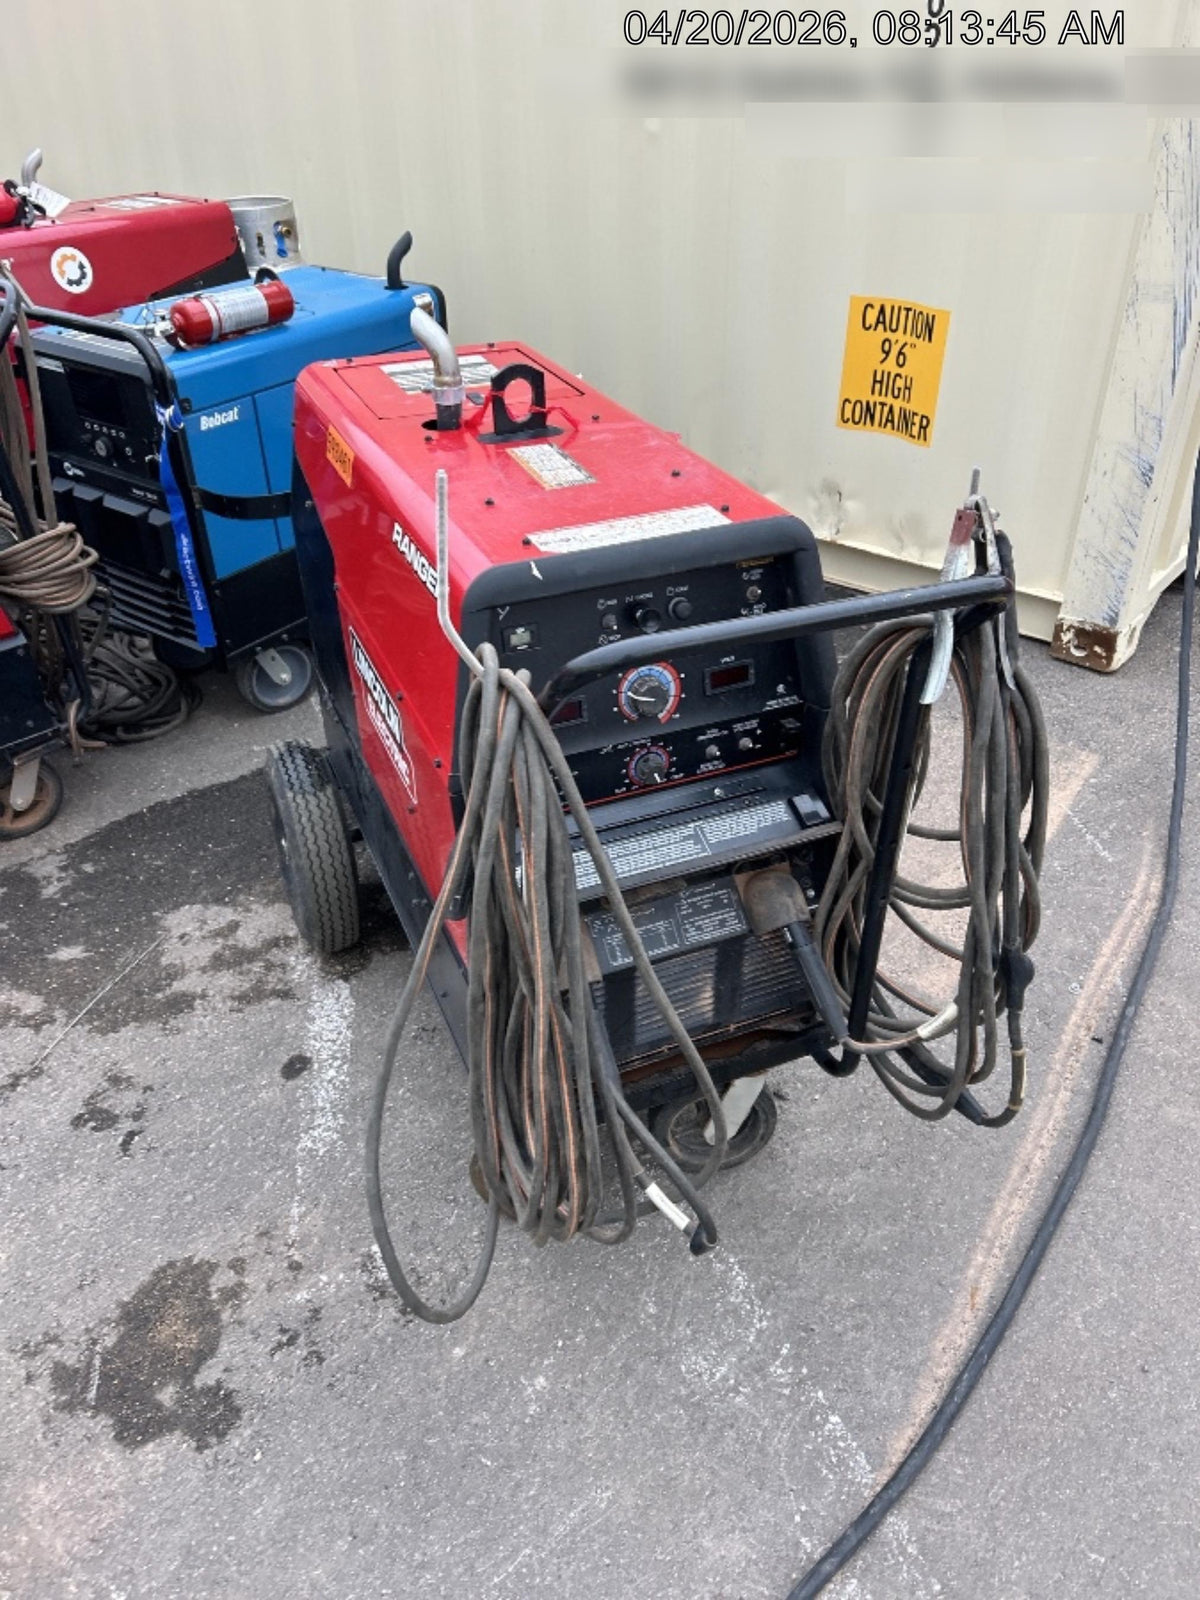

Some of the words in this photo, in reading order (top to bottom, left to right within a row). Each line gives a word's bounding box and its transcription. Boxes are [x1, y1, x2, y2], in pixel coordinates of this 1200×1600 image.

[862, 303, 935, 343] CAUTION
[871, 369, 913, 404] HIGH
[200, 406, 239, 431] Bobcat
[841, 398, 930, 442] CONTAINER
[393, 521, 439, 600] RANGE
